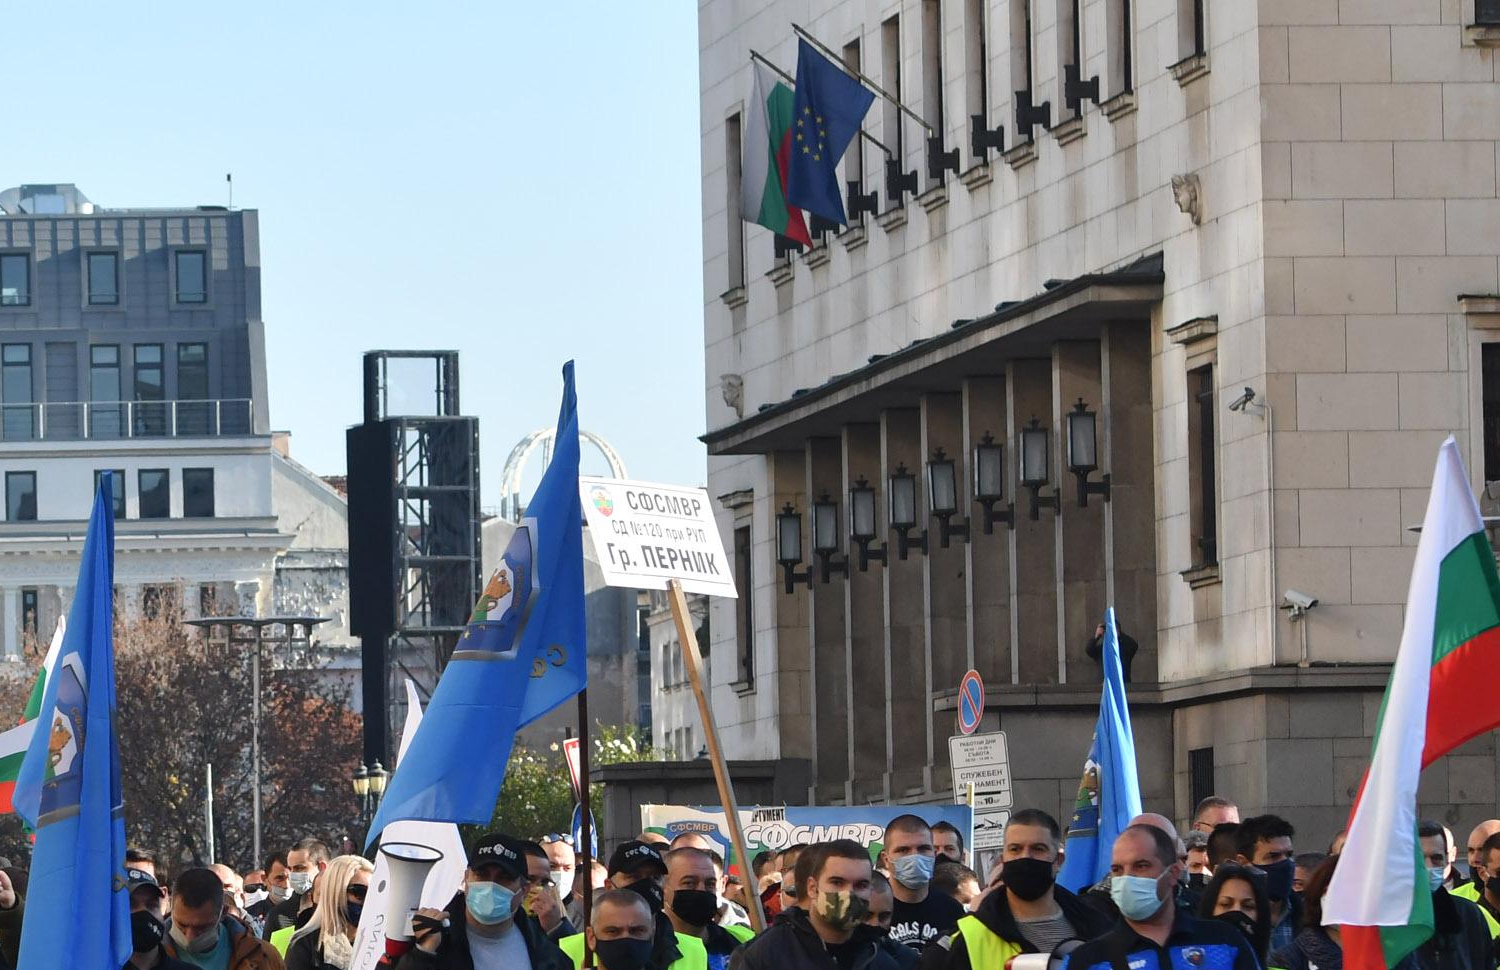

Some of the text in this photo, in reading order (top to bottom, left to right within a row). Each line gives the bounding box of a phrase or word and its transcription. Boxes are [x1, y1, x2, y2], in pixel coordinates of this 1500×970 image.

[626, 490, 702, 518] СФСМВР
[612, 520, 628, 537] СД
[666, 528, 684, 543] при
[687, 528, 707, 543] РУП
[641, 545, 720, 576] ПЕРНИК
[960, 769, 1003, 780] СЛУЖЕБЕН
[984, 796, 994, 805] 10
